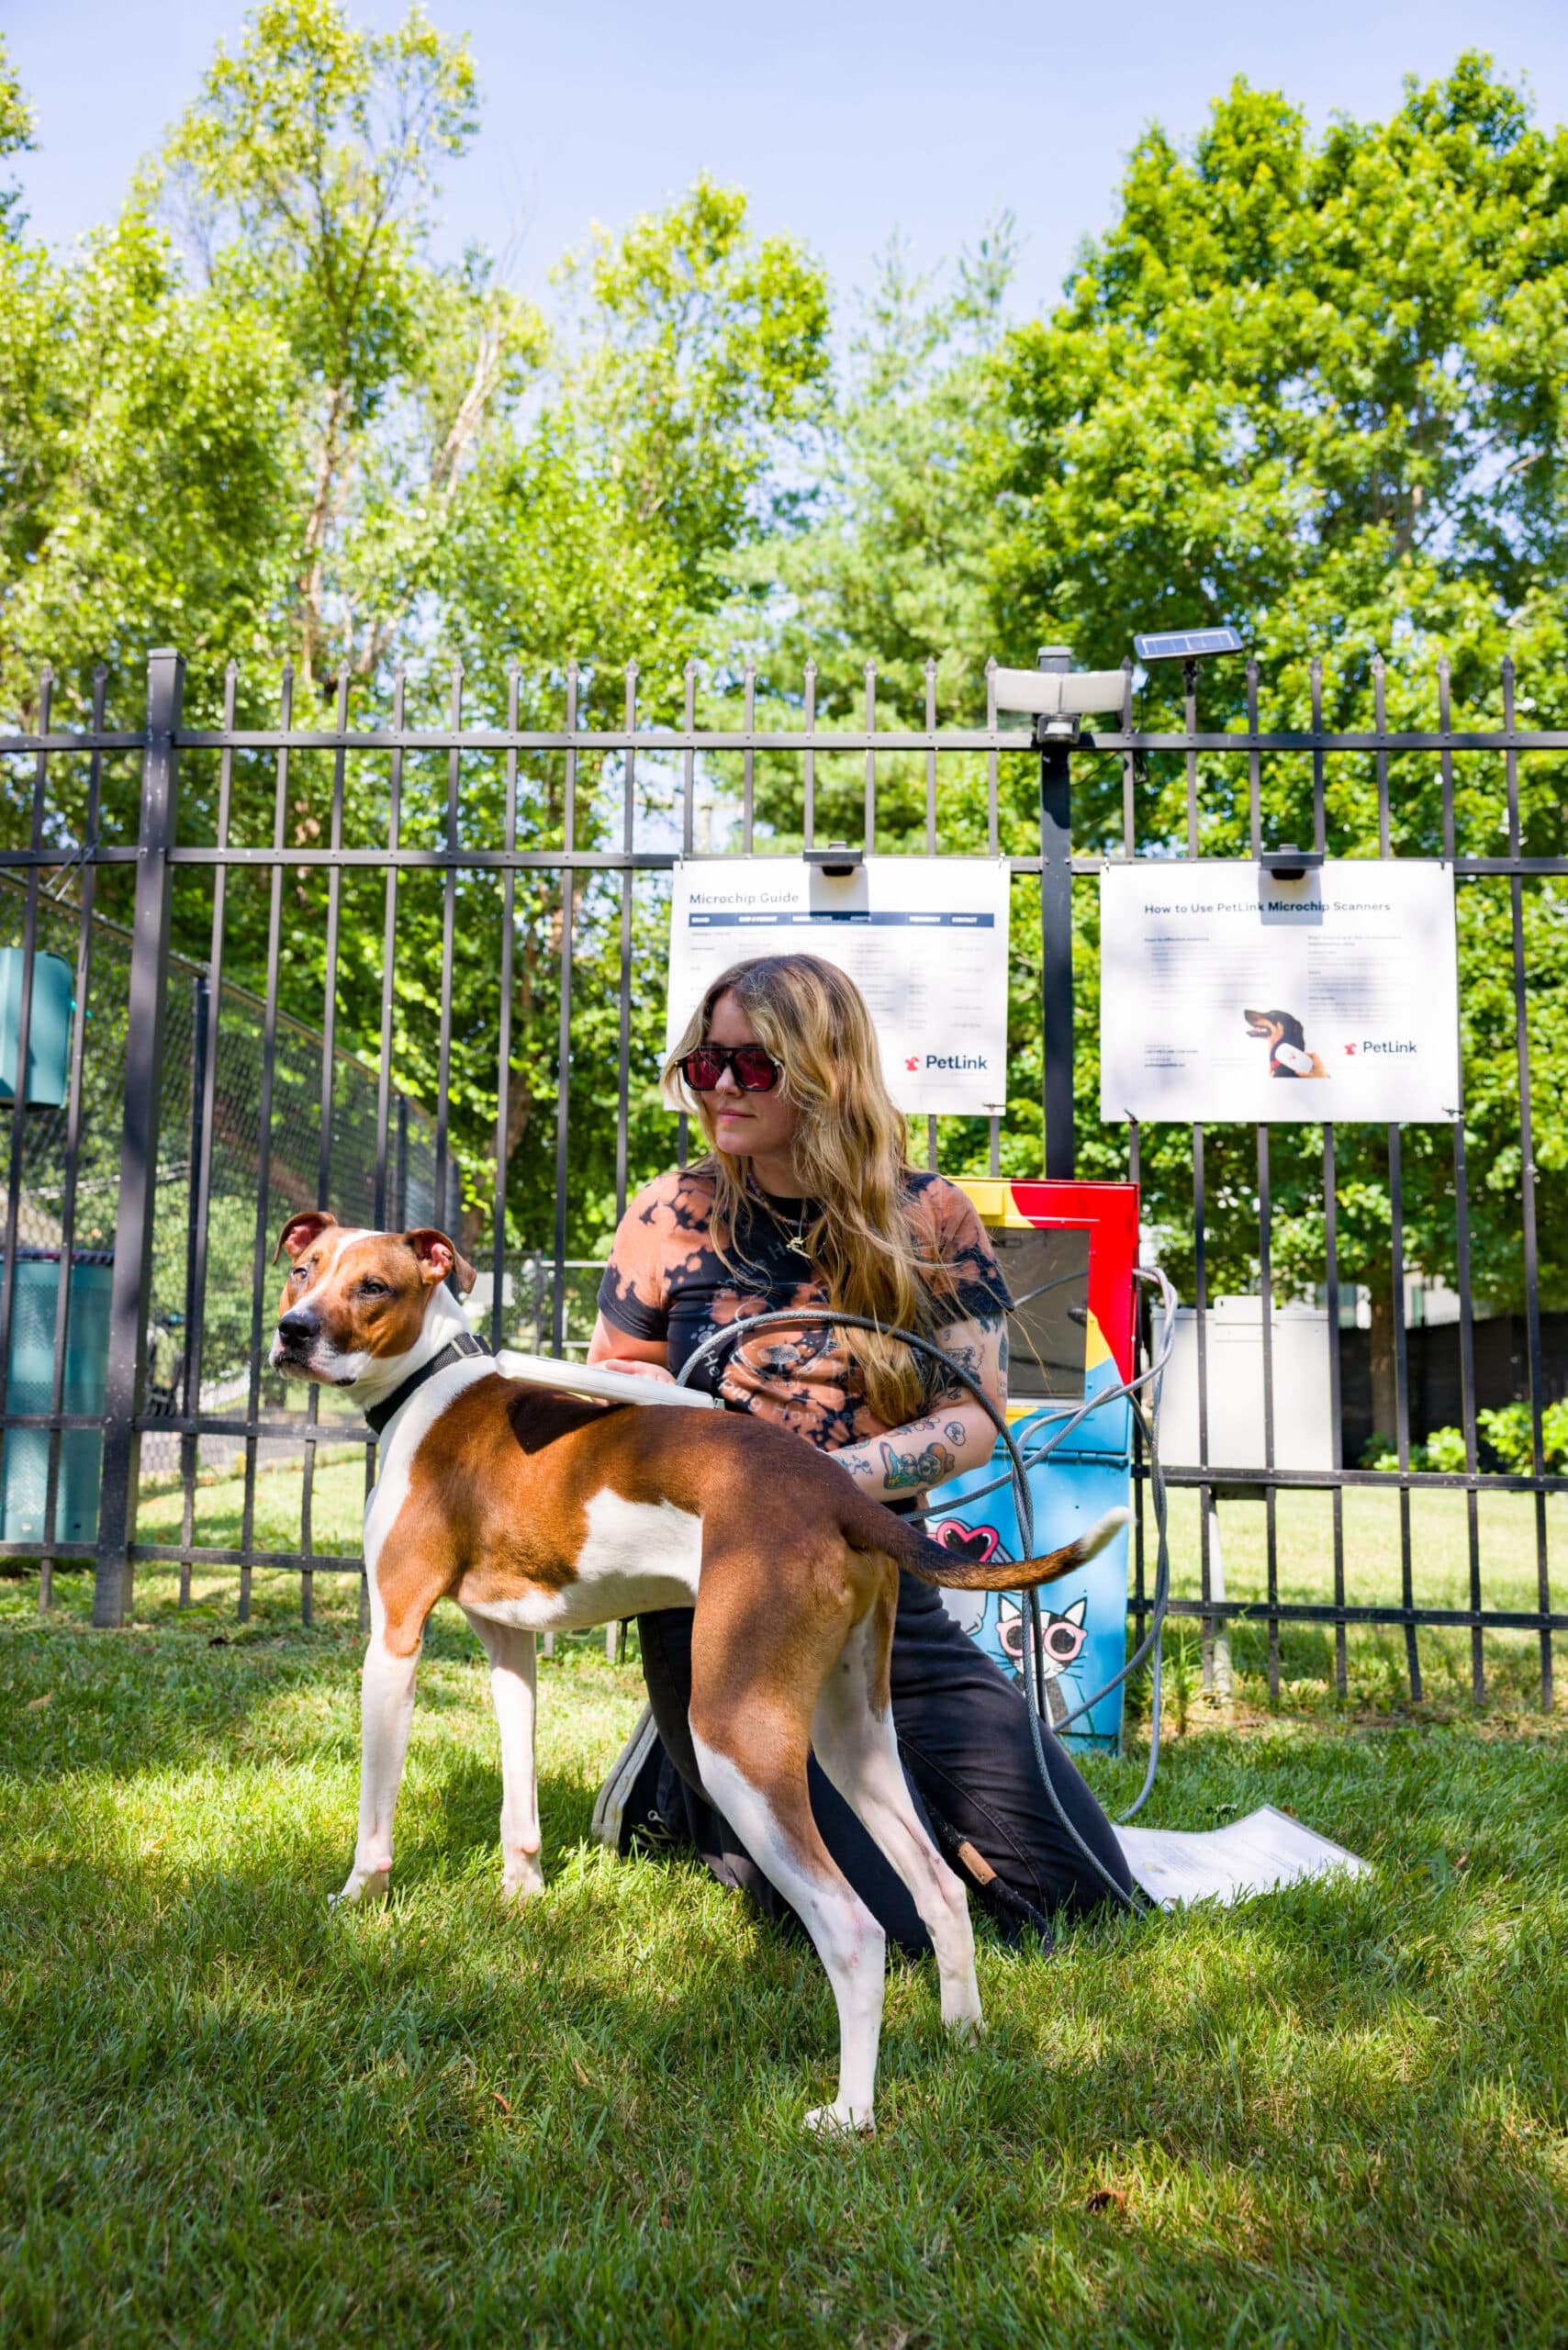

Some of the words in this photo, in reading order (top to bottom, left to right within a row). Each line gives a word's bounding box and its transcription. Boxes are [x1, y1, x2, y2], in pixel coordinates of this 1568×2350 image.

[689, 892, 756, 905] Microchip
[759, 892, 800, 903] Guide
[1145, 902, 1170, 914] How
[1175, 904, 1187, 912] to
[1191, 903, 1214, 912] Use
[1217, 901, 1264, 912] PetLink
[1268, 901, 1329, 913] Microchip
[1333, 901, 1391, 912] Scanners
[1362, 1040, 1417, 1053] PetLink
[926, 1055, 988, 1069] PetLink
